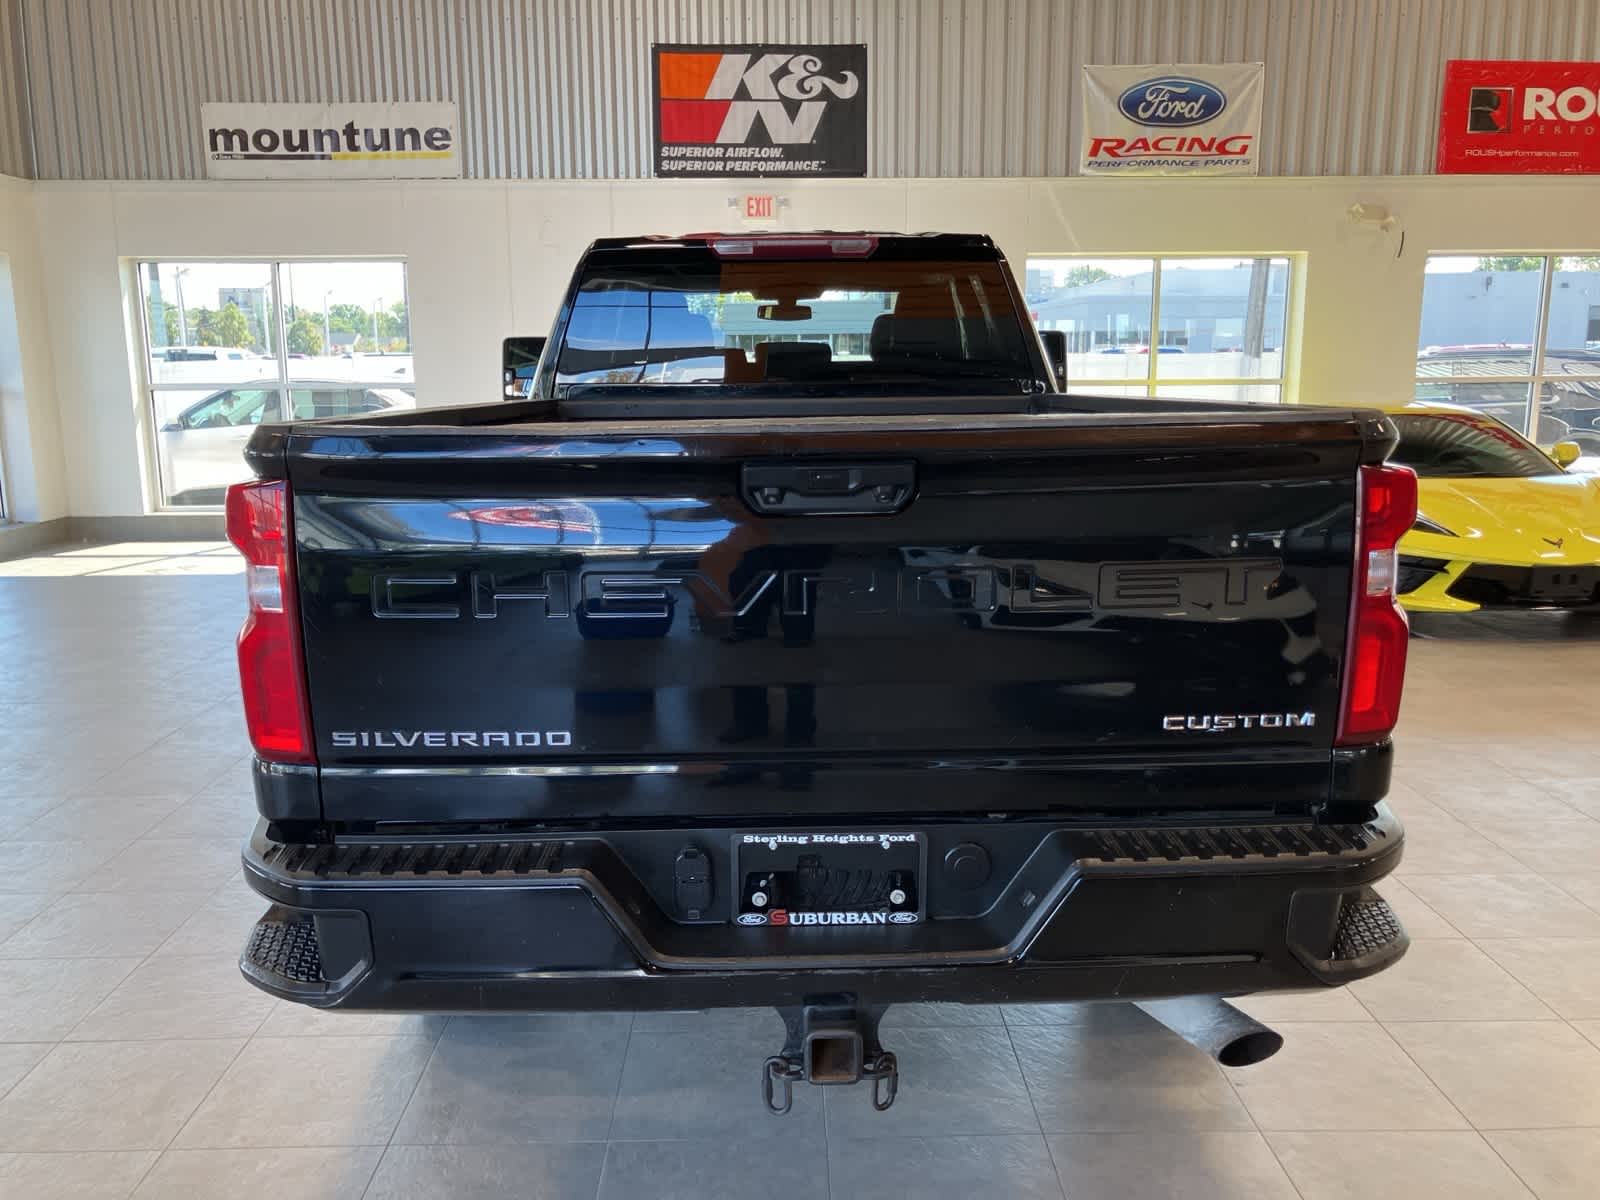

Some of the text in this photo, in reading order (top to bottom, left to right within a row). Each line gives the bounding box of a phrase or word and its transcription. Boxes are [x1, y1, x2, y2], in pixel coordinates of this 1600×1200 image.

[1138, 85, 1206, 119] Ford
[1523, 86, 1600, 122] RO
[209, 120, 452, 153] mountune
[661, 147, 784, 158] SUPERIOR AIRFLOW.
[1088, 136, 1253, 158] RACING
[661, 160, 724, 171] SUPERIOR
[1087, 158, 1251, 168] PERFORMANCE PARTS
[747, 196, 773, 217] EXIT
[370, 557, 1284, 620] CHEVROLET
[1163, 711, 1316, 731] CUSTOM
[331, 730, 573, 748] SILVERADO
[743, 834, 916, 844] Sterling Heights Ford
[770, 909, 887, 925] SUBURBAN
